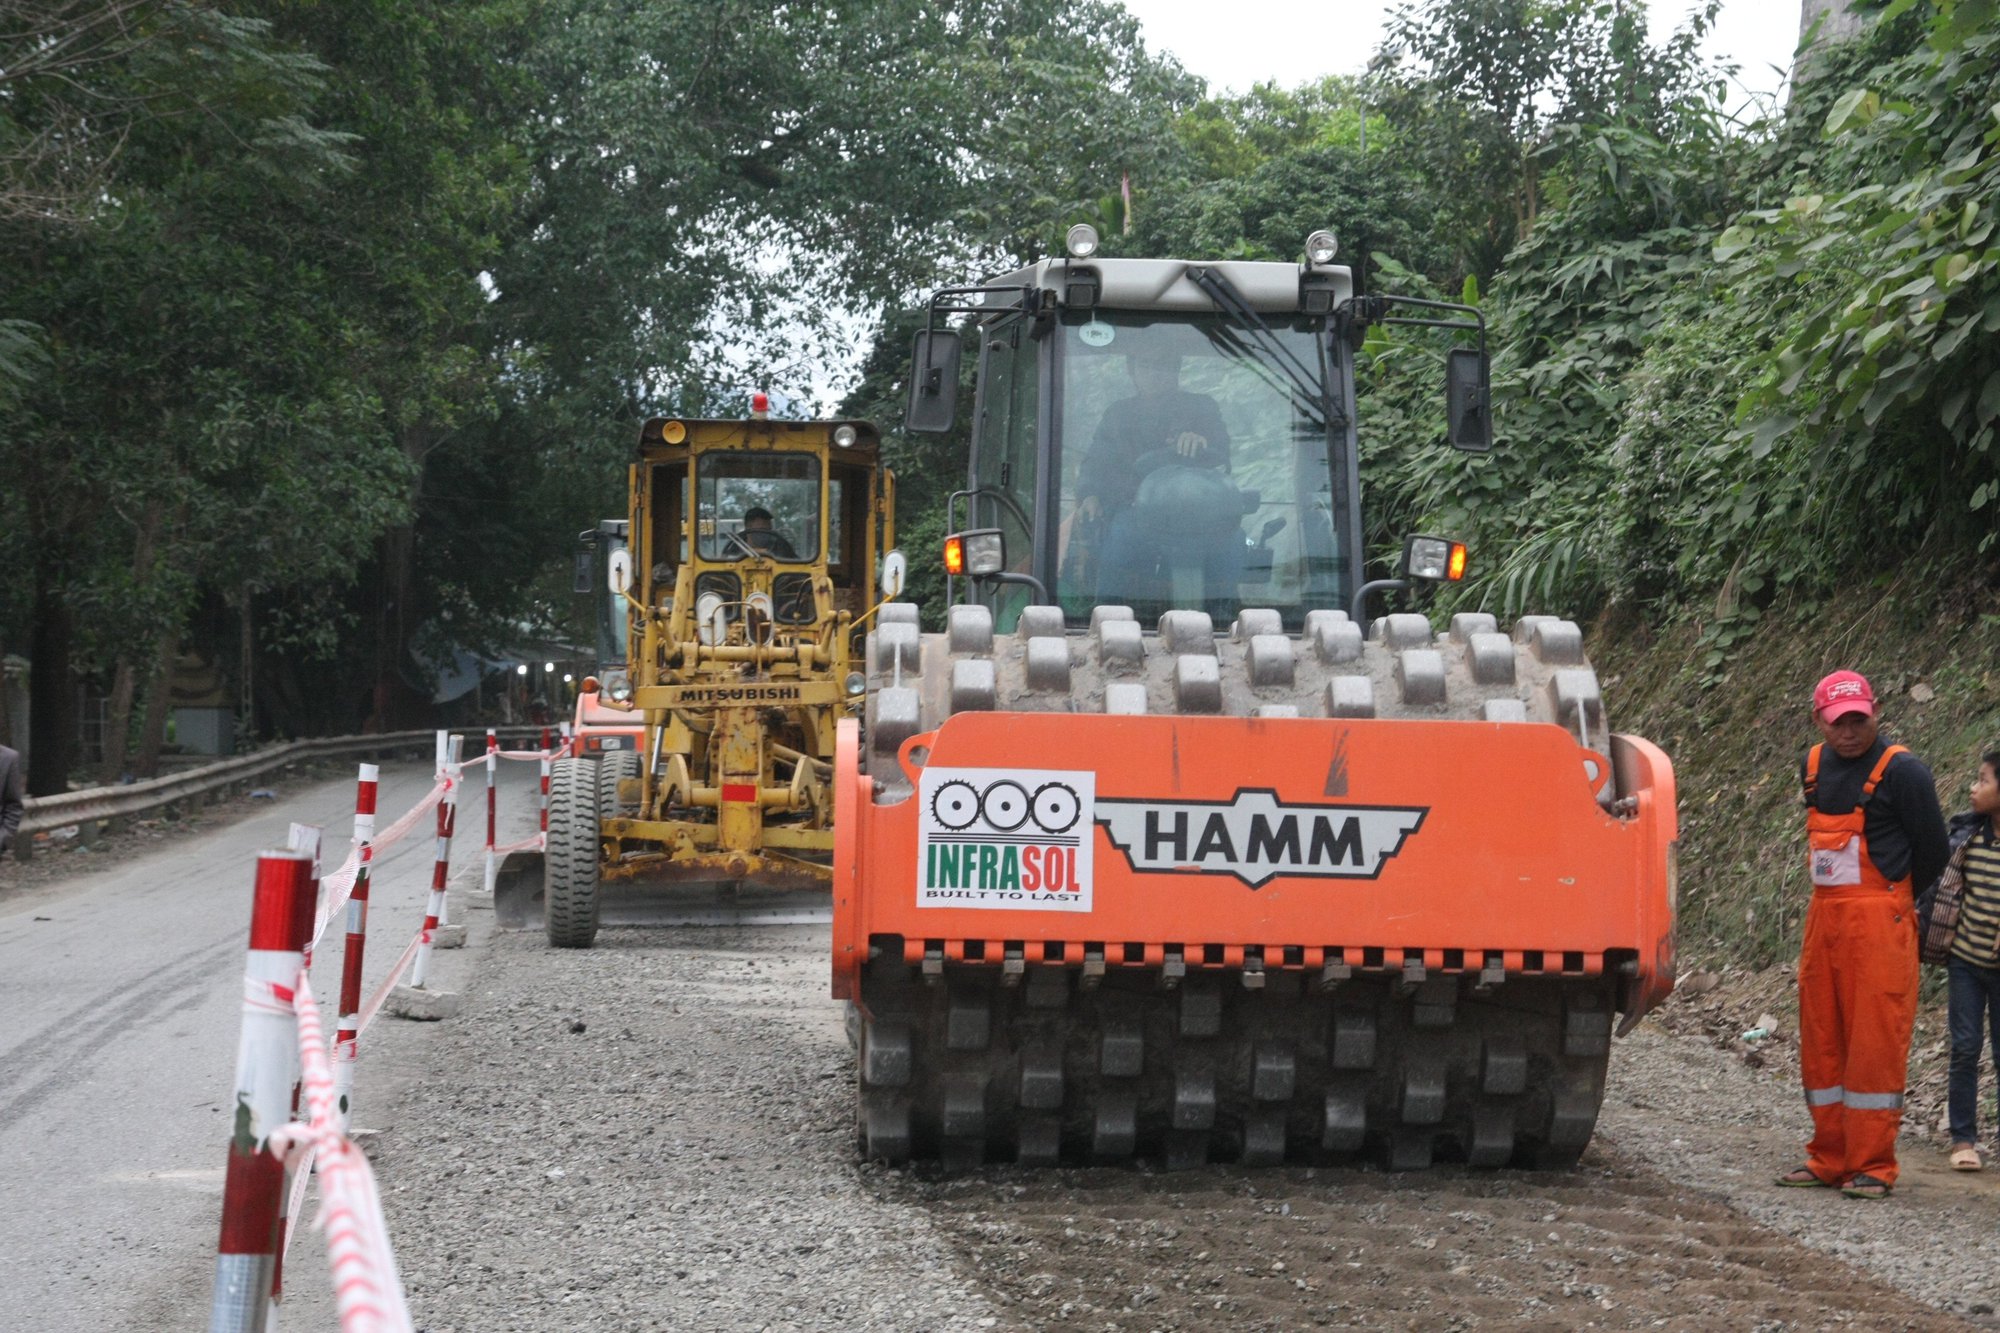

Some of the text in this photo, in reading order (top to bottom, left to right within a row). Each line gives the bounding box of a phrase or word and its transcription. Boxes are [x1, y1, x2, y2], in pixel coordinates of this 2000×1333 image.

[681, 688, 799, 701] MITSUBISHI
[1145, 810, 1365, 866] HAMM
[926, 844, 1080, 892] INFRASOL
[926, 890, 1083, 902] BUILT TO LAST
